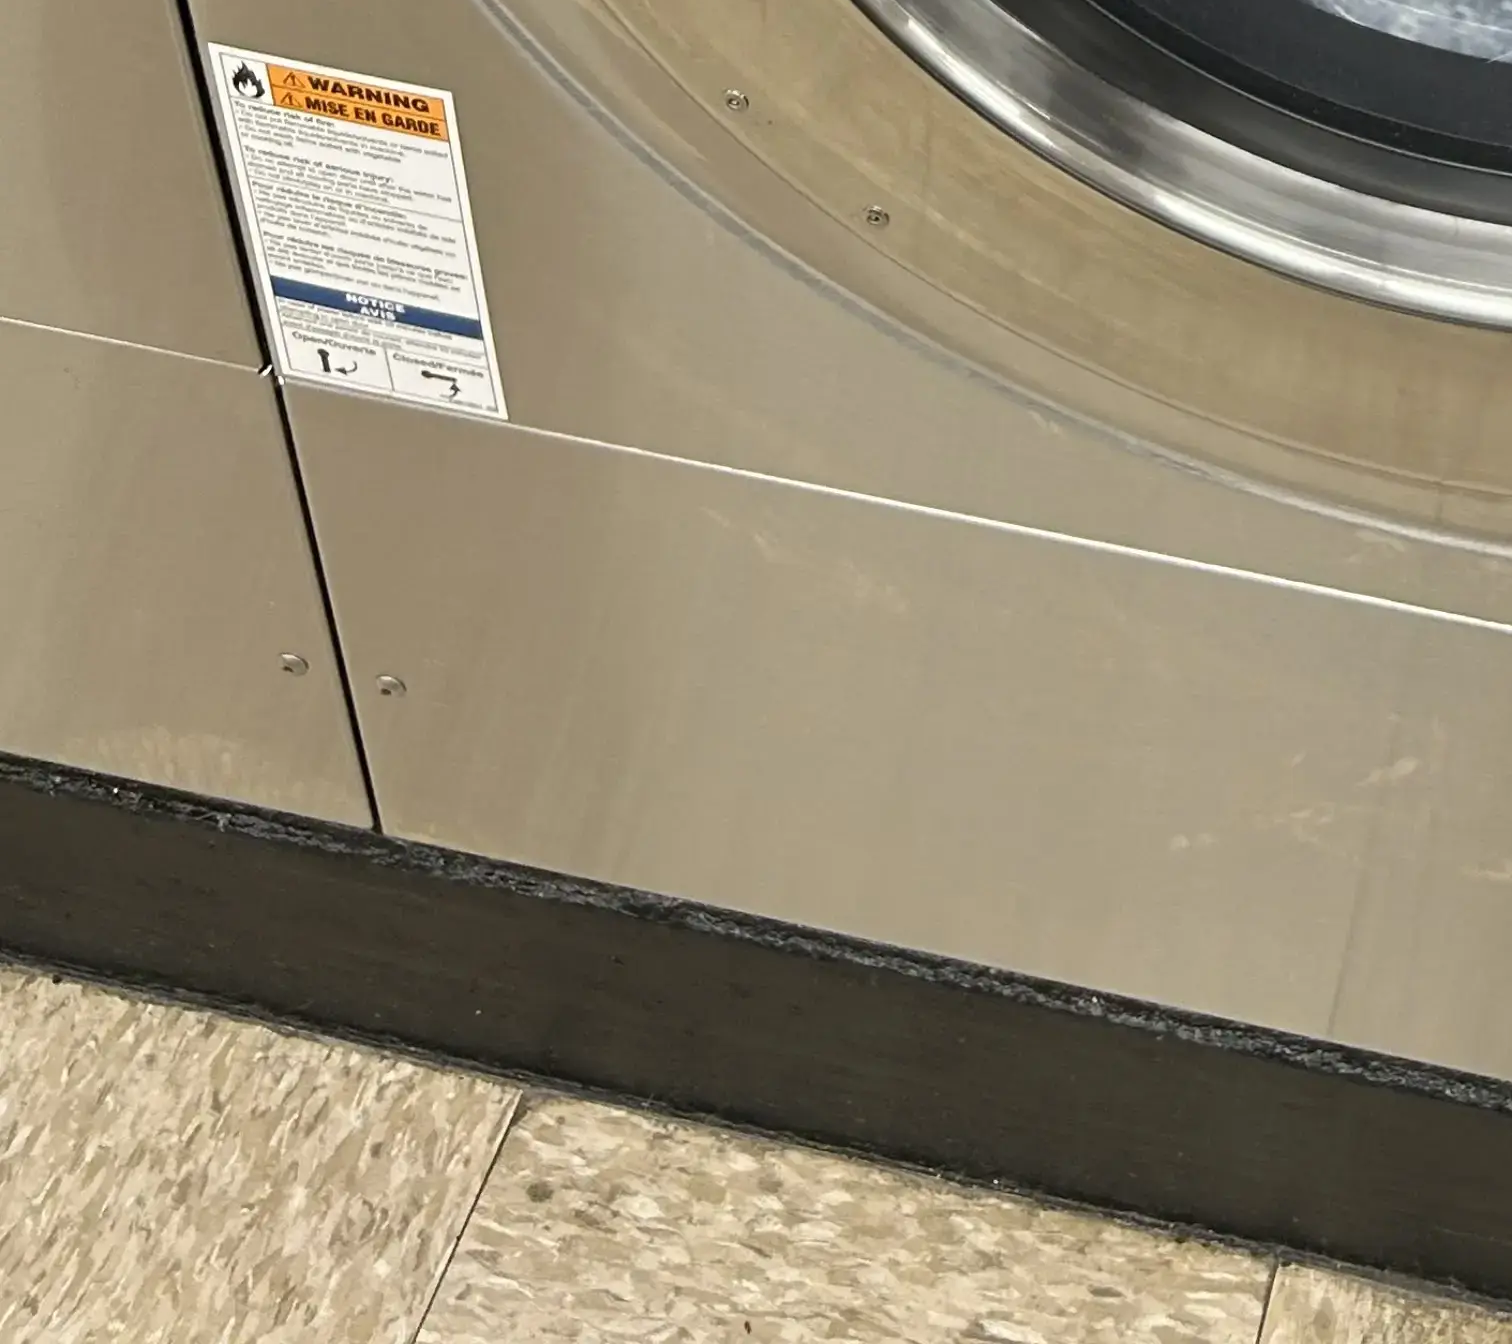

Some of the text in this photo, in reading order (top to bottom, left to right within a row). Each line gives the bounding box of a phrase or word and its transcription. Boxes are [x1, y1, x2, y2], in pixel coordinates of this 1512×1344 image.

[307, 75, 430, 113] WARNING
[304, 96, 349, 117] MISE
[354, 107, 377, 123] EN
[382, 113, 441, 137] GARDE
[345, 292, 406, 314] NOTICE
[360, 306, 397, 322] AVIS
